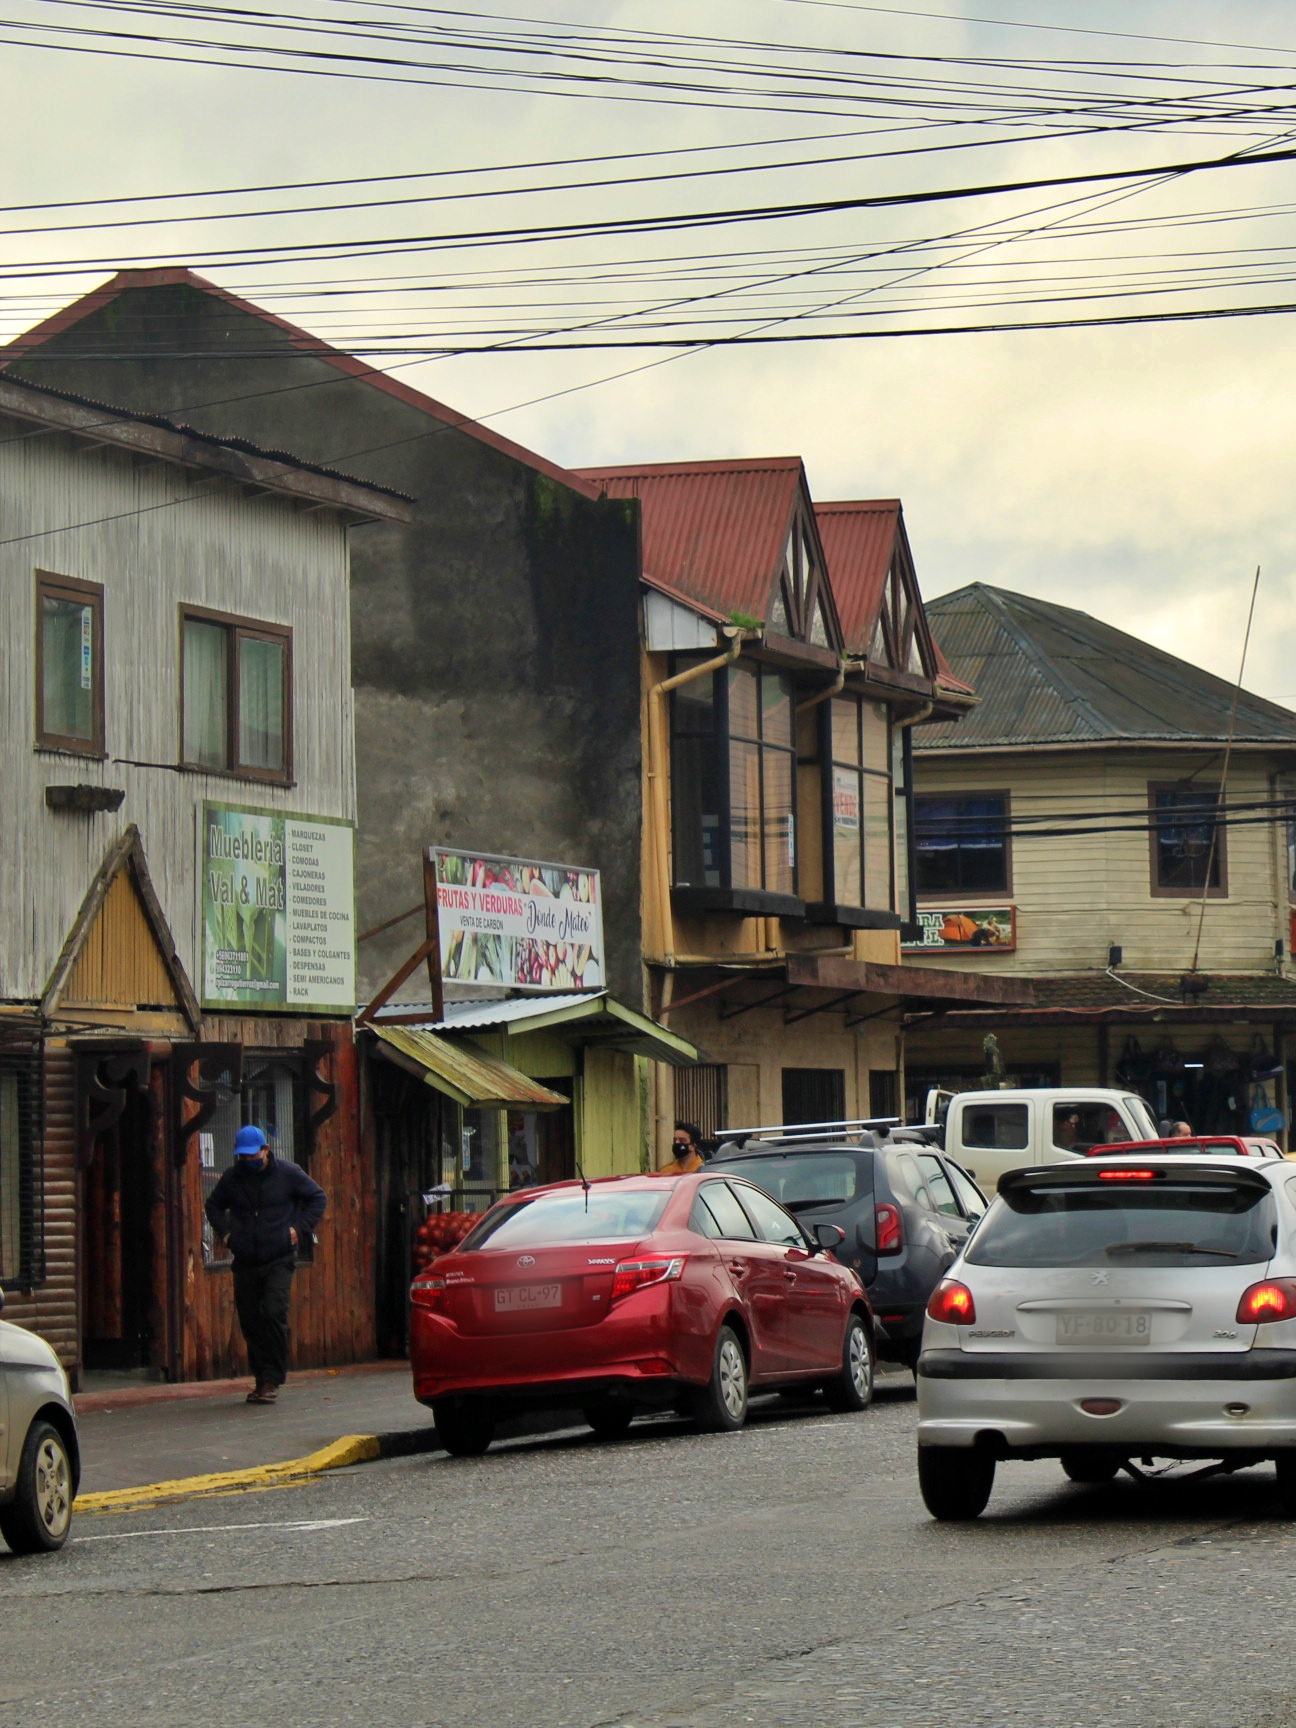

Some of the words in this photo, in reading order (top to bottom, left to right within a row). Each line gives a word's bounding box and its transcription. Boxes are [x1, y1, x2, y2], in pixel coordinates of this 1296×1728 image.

[292, 829, 325, 841] MARQUEZAS
[292, 843, 313, 853] CLOSET
[292, 856, 319, 867] COMODAS
[292, 869, 325, 880] CAJONERAS
[210, 871, 234, 905] Val
[240, 874, 250, 905] &
[256, 876, 284, 909] Mat
[292, 882, 325, 893] VELADORES
[292, 895, 326, 906] COMEDORES
[437, 888, 469, 910] FRUTAS
[471, 892, 477, 911] Y
[479, 893, 523, 916] VERDURAS
[293, 908, 319, 918] MUEBLES
[320, 911, 327, 920] DE
[328, 911, 350, 921] COCINA
[293, 922, 327, 932] LAVAPLATOS
[460, 916, 475, 927] VENTA
[476, 917, 483, 928] DE
[484, 917, 504, 931] CARBÓN
[293, 935, 327, 945] COMPACTOS
[293, 948, 311, 957] BASES
[318, 950, 350, 960] COLGANTES
[293, 961, 326, 972] DESPENSAS
[293, 974, 306, 983] SEMI
[308, 976, 344, 985] AMERICANOS
[293, 988, 309, 996] RACK
[968, 1330, 1016, 1339] PEUGEOT
[1212, 1329, 1238, 1340] 206
